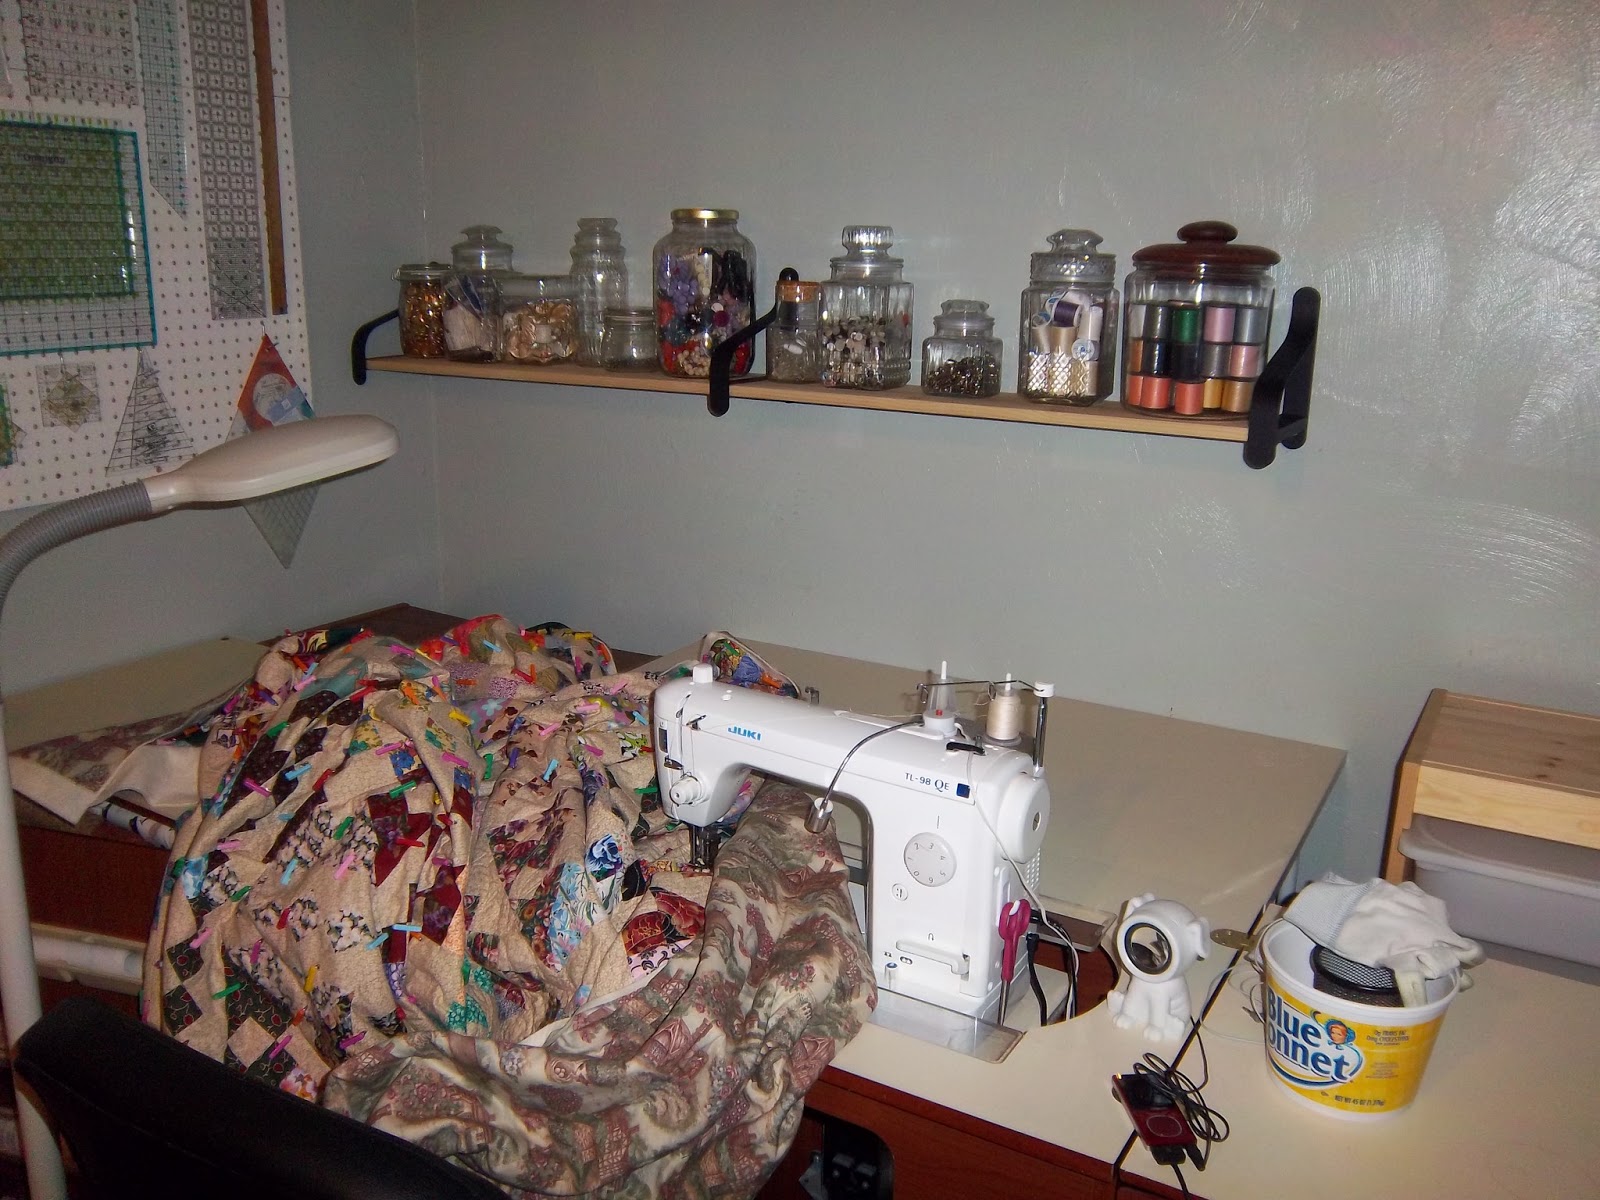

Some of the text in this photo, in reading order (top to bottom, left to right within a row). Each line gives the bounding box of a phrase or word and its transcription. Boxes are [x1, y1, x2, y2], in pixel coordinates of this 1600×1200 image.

[727, 725, 761, 741] JUKI
[904, 772, 950, 792] TL-98 QE
[929, 842, 935, 850] 3
[1267, 984, 1322, 1048] Blue
[1267, 1020, 1350, 1081] onnet
